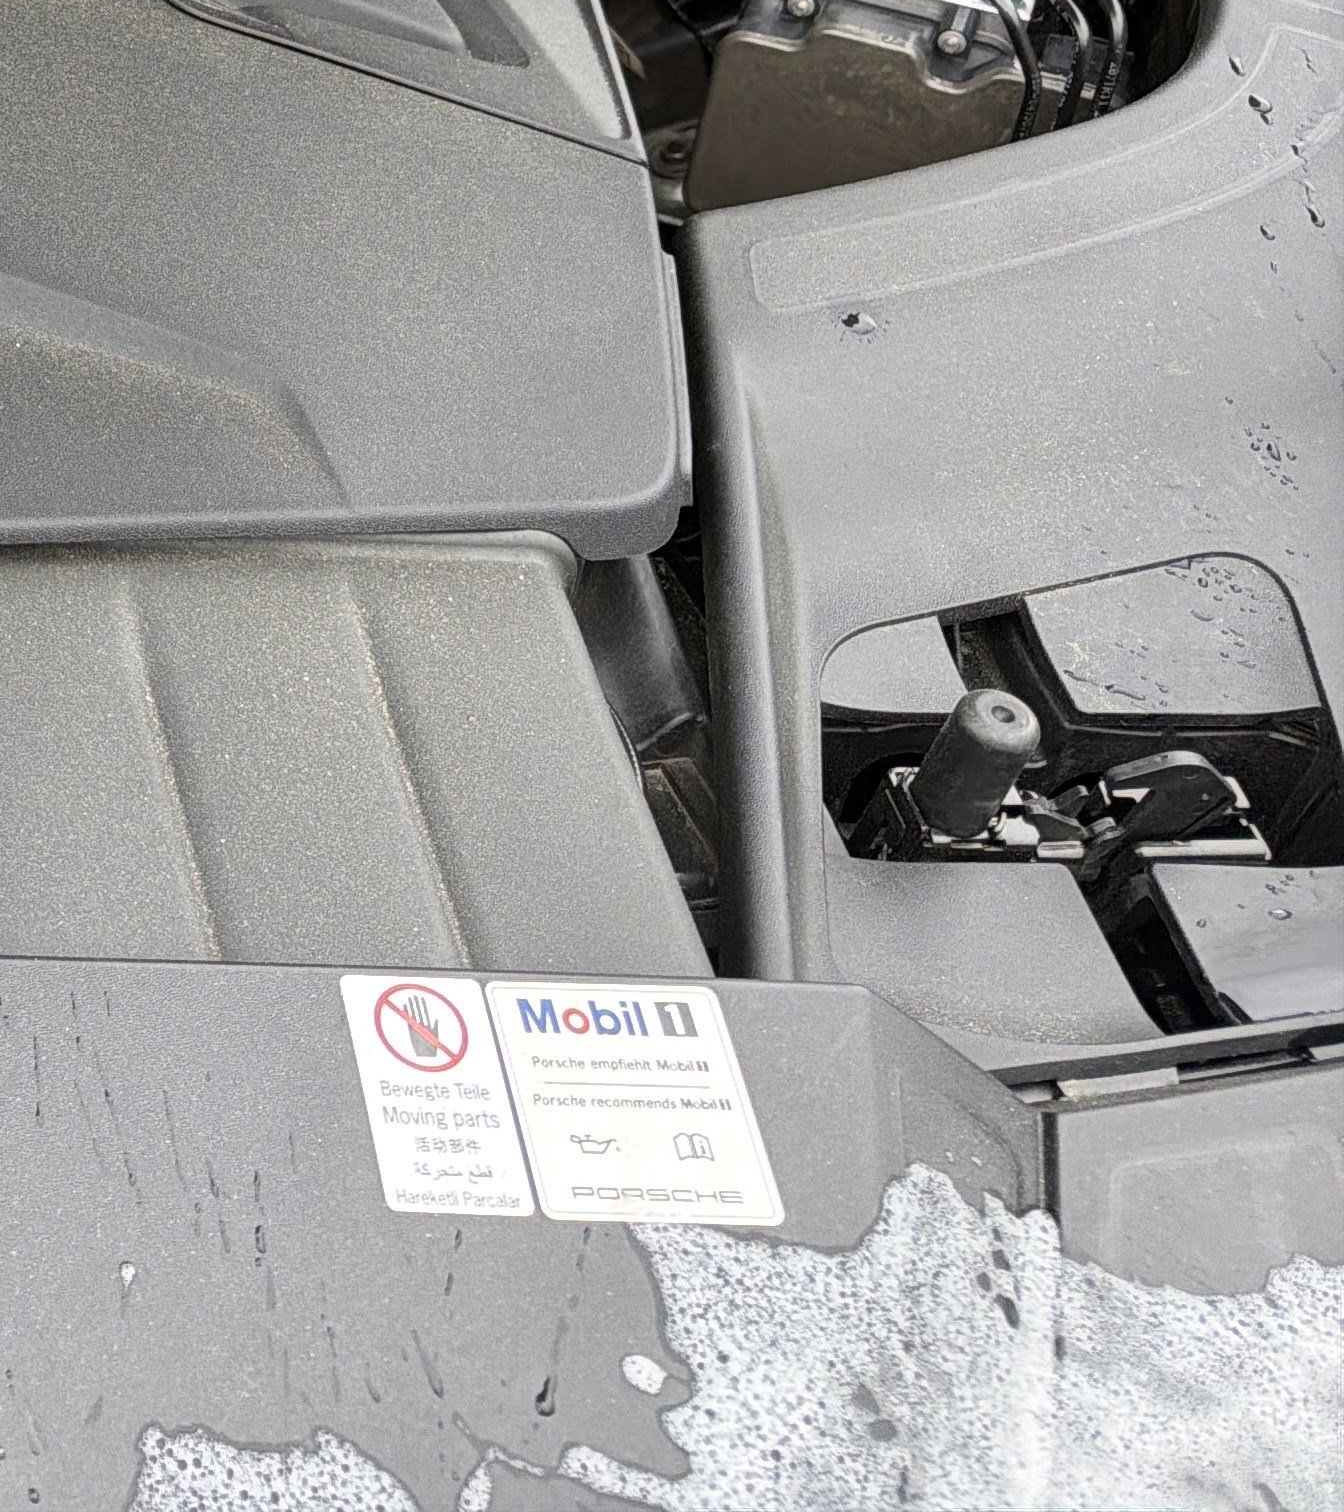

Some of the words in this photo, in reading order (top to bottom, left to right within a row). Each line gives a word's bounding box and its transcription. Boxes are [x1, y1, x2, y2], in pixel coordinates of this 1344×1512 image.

[516, 998, 649, 1036] Mobil
[658, 1001, 694, 1037] 1
[532, 1056, 586, 1069] Porsche
[591, 1058, 652, 1072] empfiehlt
[656, 1059, 695, 1072] Mobil
[379, 1080, 450, 1101] Bewegte
[453, 1082, 491, 1100] Teile
[532, 1094, 586, 1107] Porsche
[590, 1097, 677, 1110] recommends
[680, 1097, 718, 1110] Mobil
[382, 1106, 448, 1130] Moving
[453, 1107, 501, 1131] parts
[395, 1188, 459, 1206] Hareketli
[571, 1186, 744, 1204] PORSCHE
